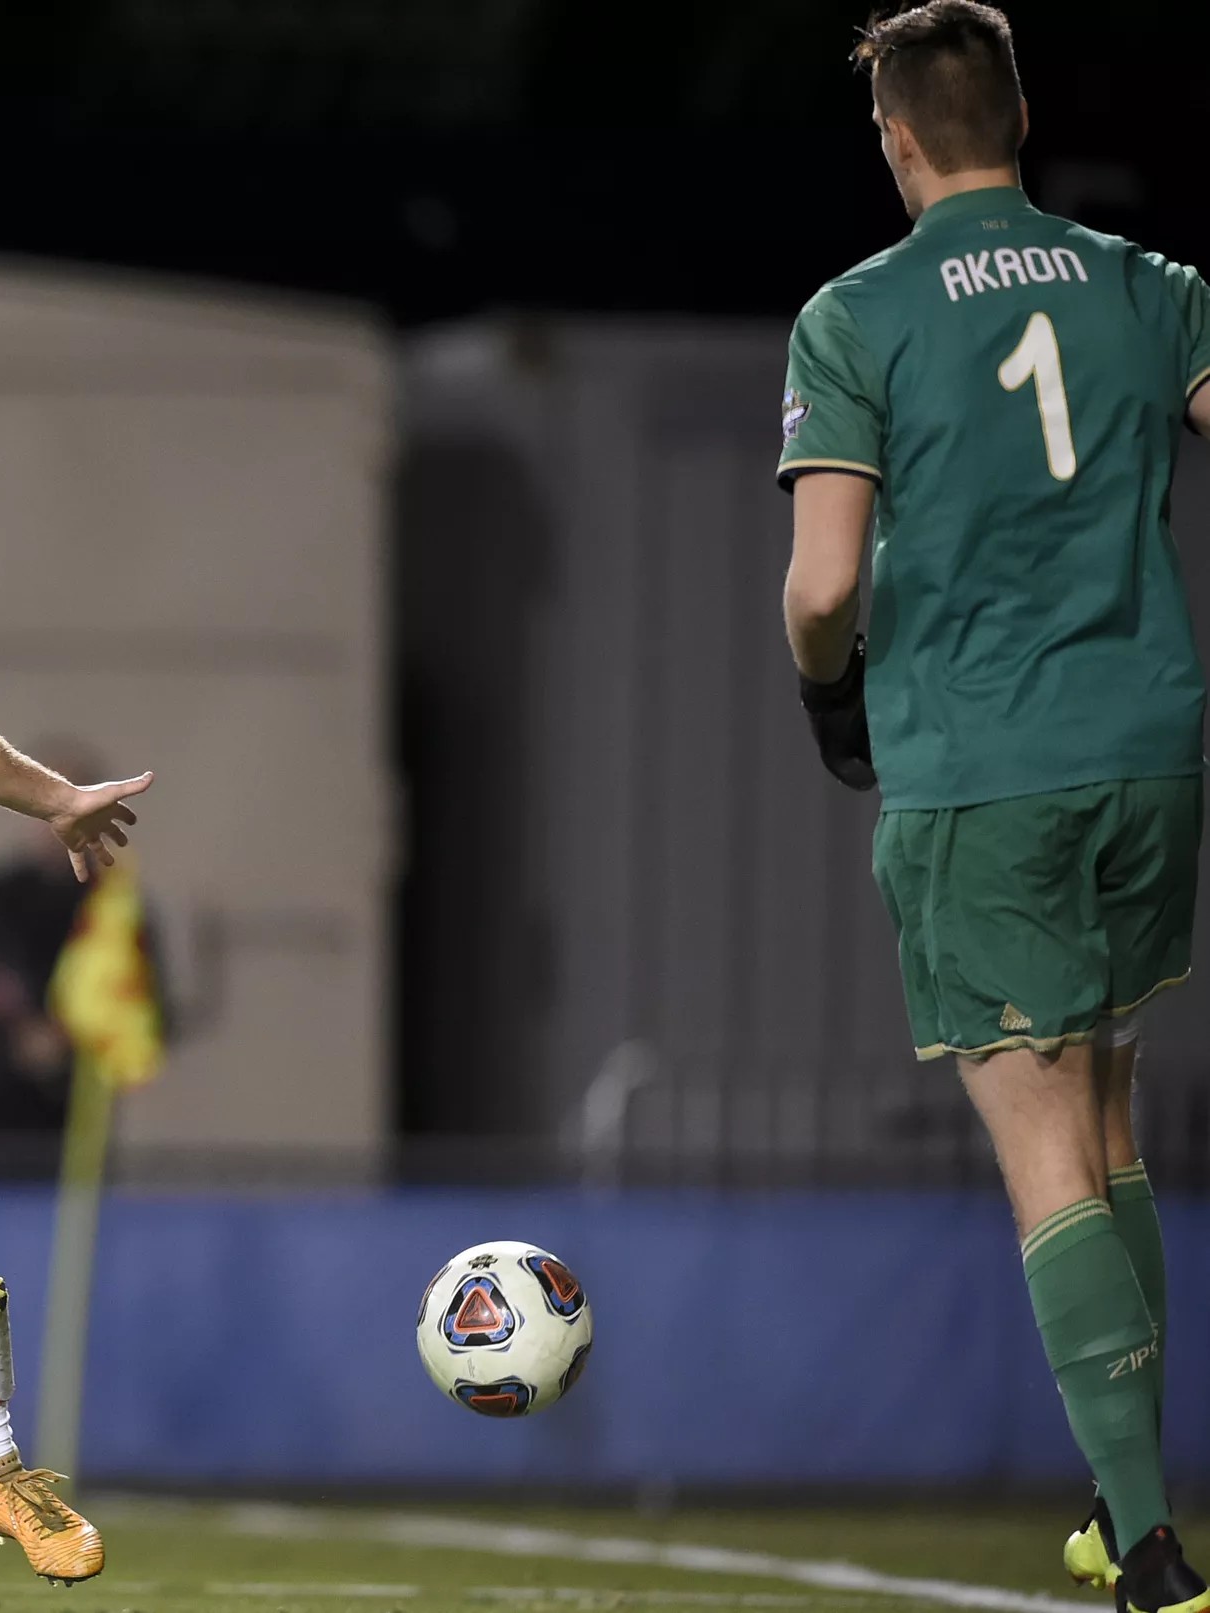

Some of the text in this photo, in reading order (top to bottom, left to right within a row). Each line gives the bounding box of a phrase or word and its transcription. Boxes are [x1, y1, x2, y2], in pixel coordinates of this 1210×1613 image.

[940, 246, 1088, 303] AKRON
[997, 311, 1077, 482] 1
[1106, 1340, 1159, 1380] ZIPS
